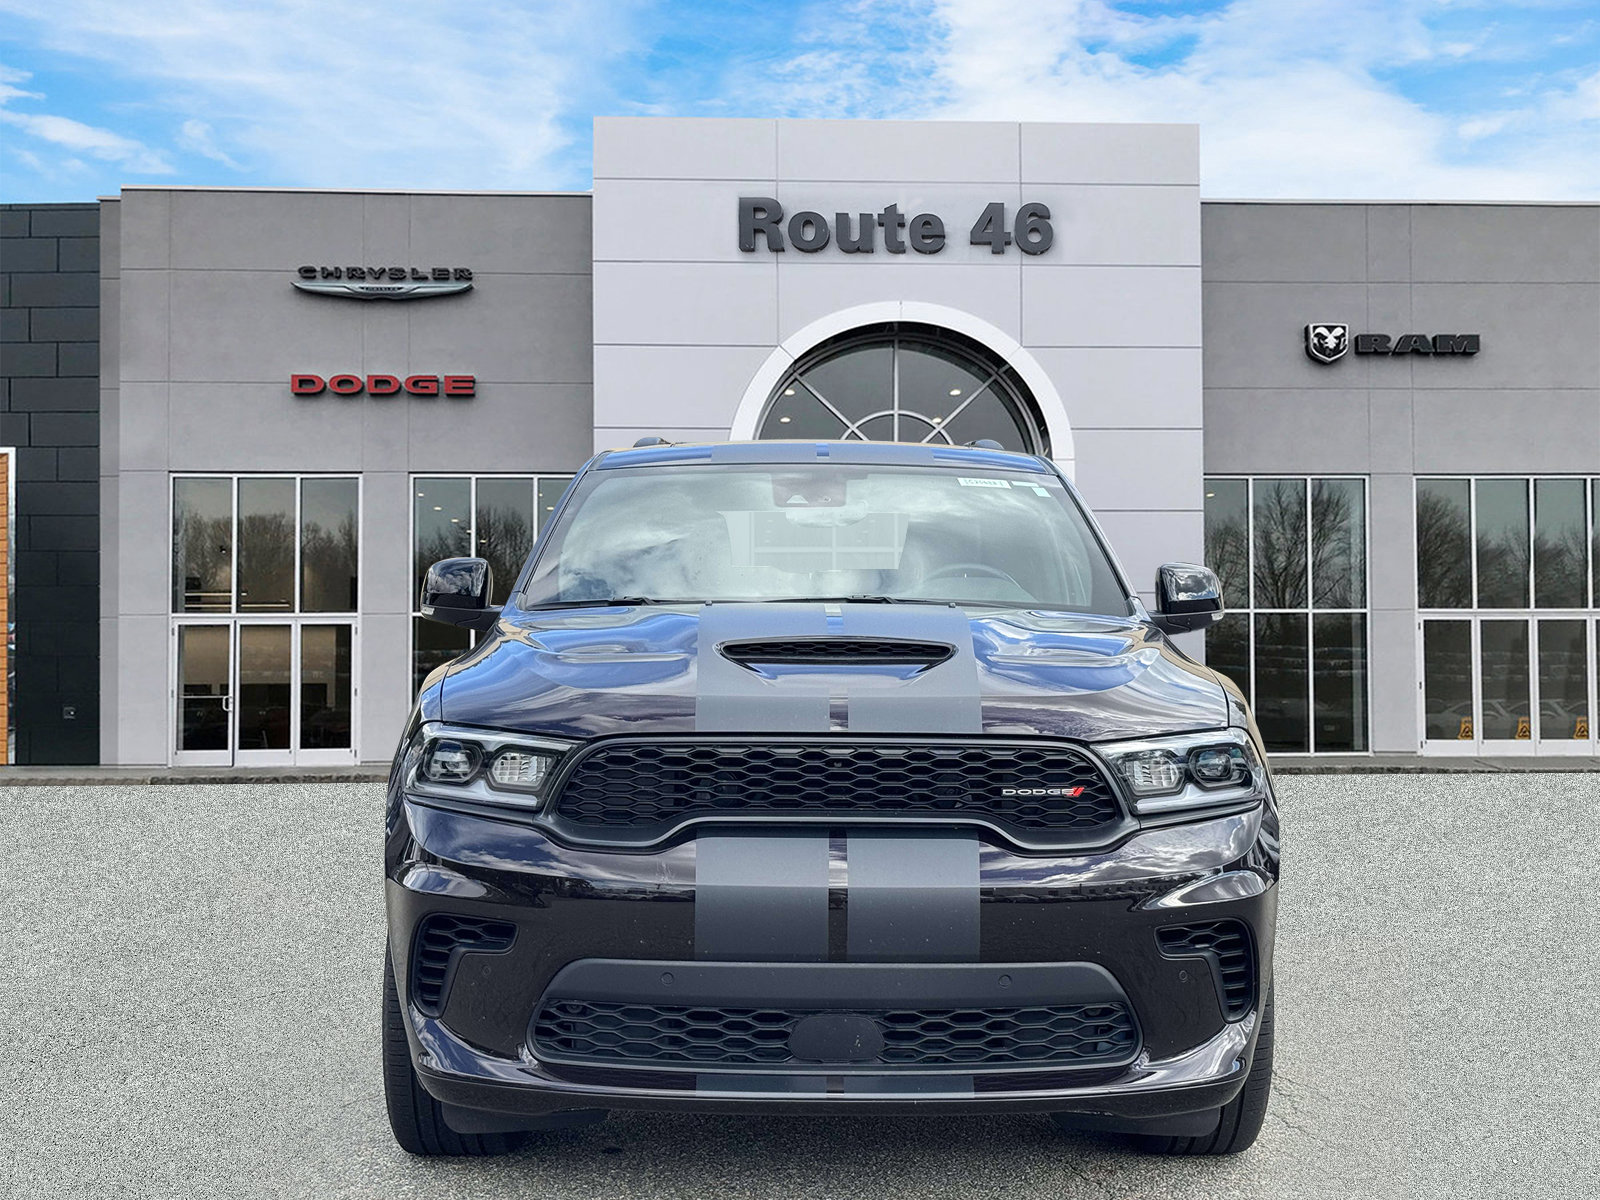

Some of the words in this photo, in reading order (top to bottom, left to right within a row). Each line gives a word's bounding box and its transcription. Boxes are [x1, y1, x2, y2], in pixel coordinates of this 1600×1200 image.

[739, 197, 946, 253] Route
[970, 202, 1054, 255] 46
[298, 265, 473, 281] CHRYSLER
[1354, 333, 1480, 356] RAM
[291, 374, 476, 397] DODGE
[1002, 788, 1075, 796] DODGE
